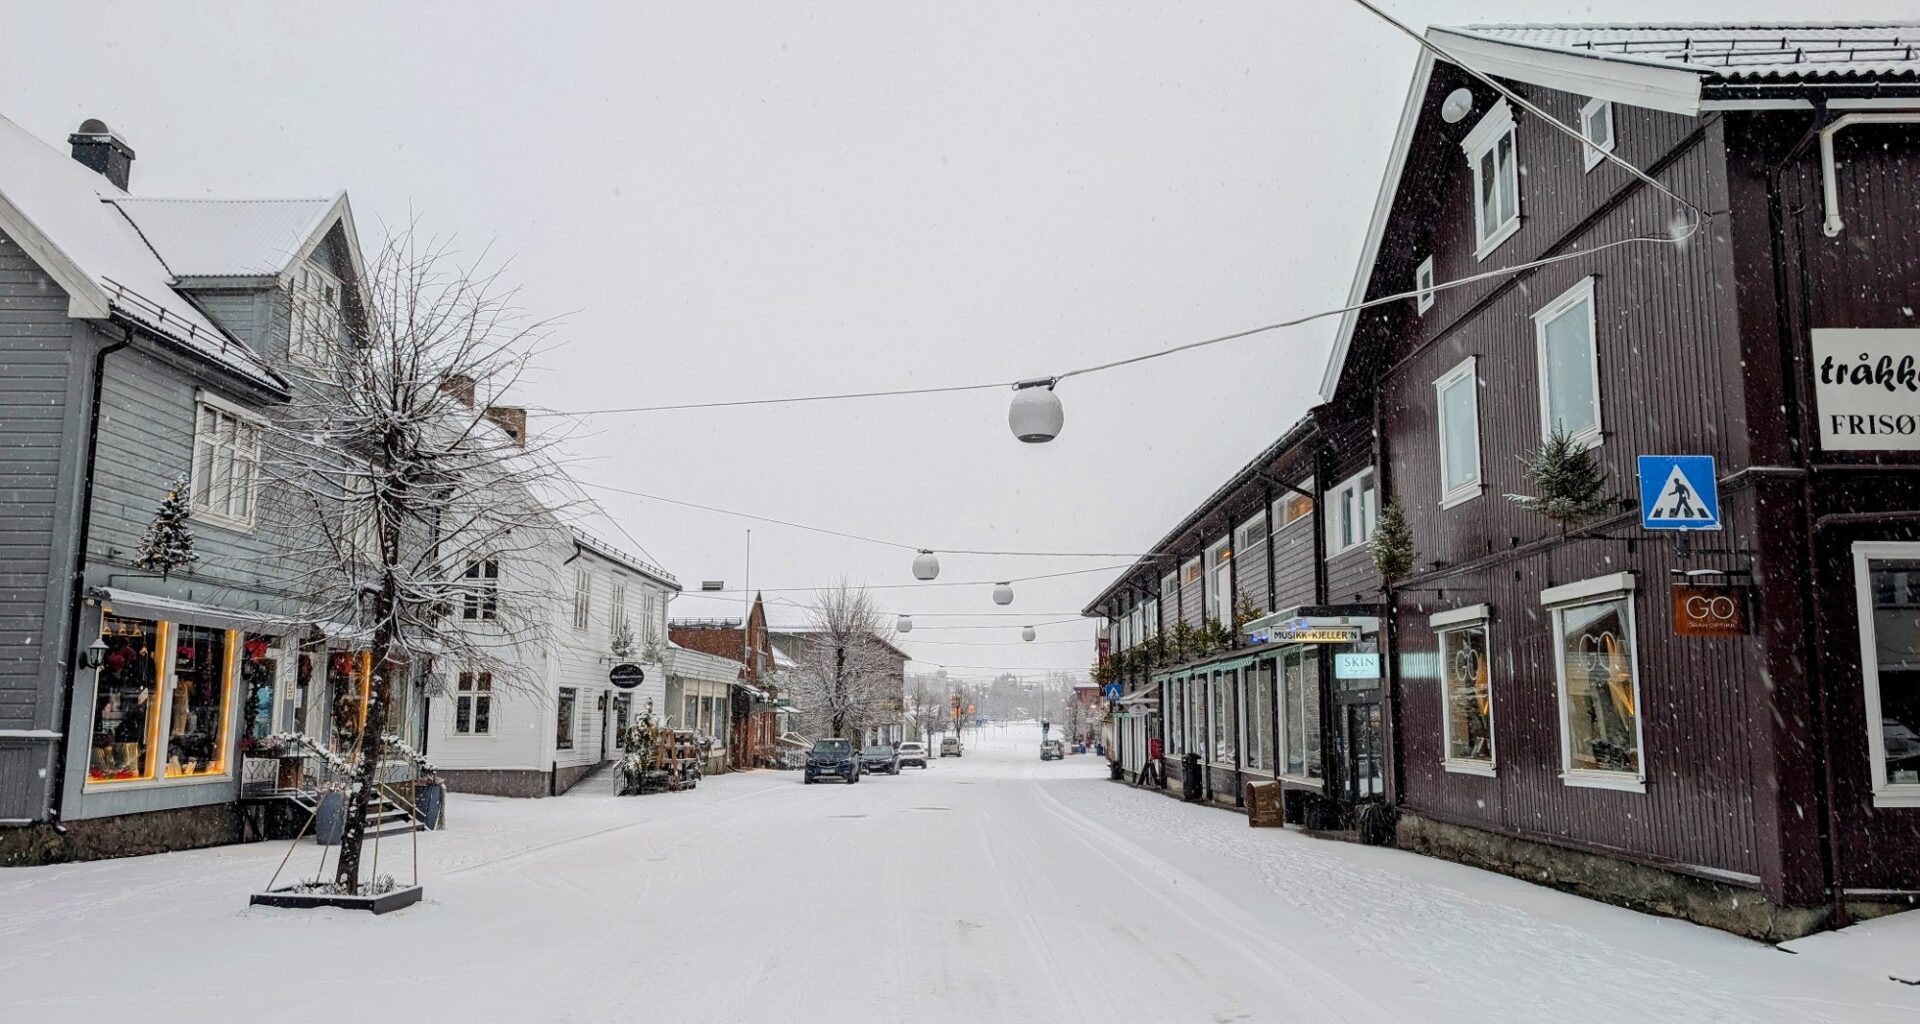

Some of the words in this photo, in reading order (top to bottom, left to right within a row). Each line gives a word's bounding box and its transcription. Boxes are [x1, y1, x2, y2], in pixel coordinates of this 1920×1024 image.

[1821, 352, 1920, 392] tråkk
[1830, 414, 1920, 435] FRISØ
[1686, 595, 1735, 619] GO
[1344, 656, 1375, 667] SKIN
[1456, 649, 1479, 681] GO
